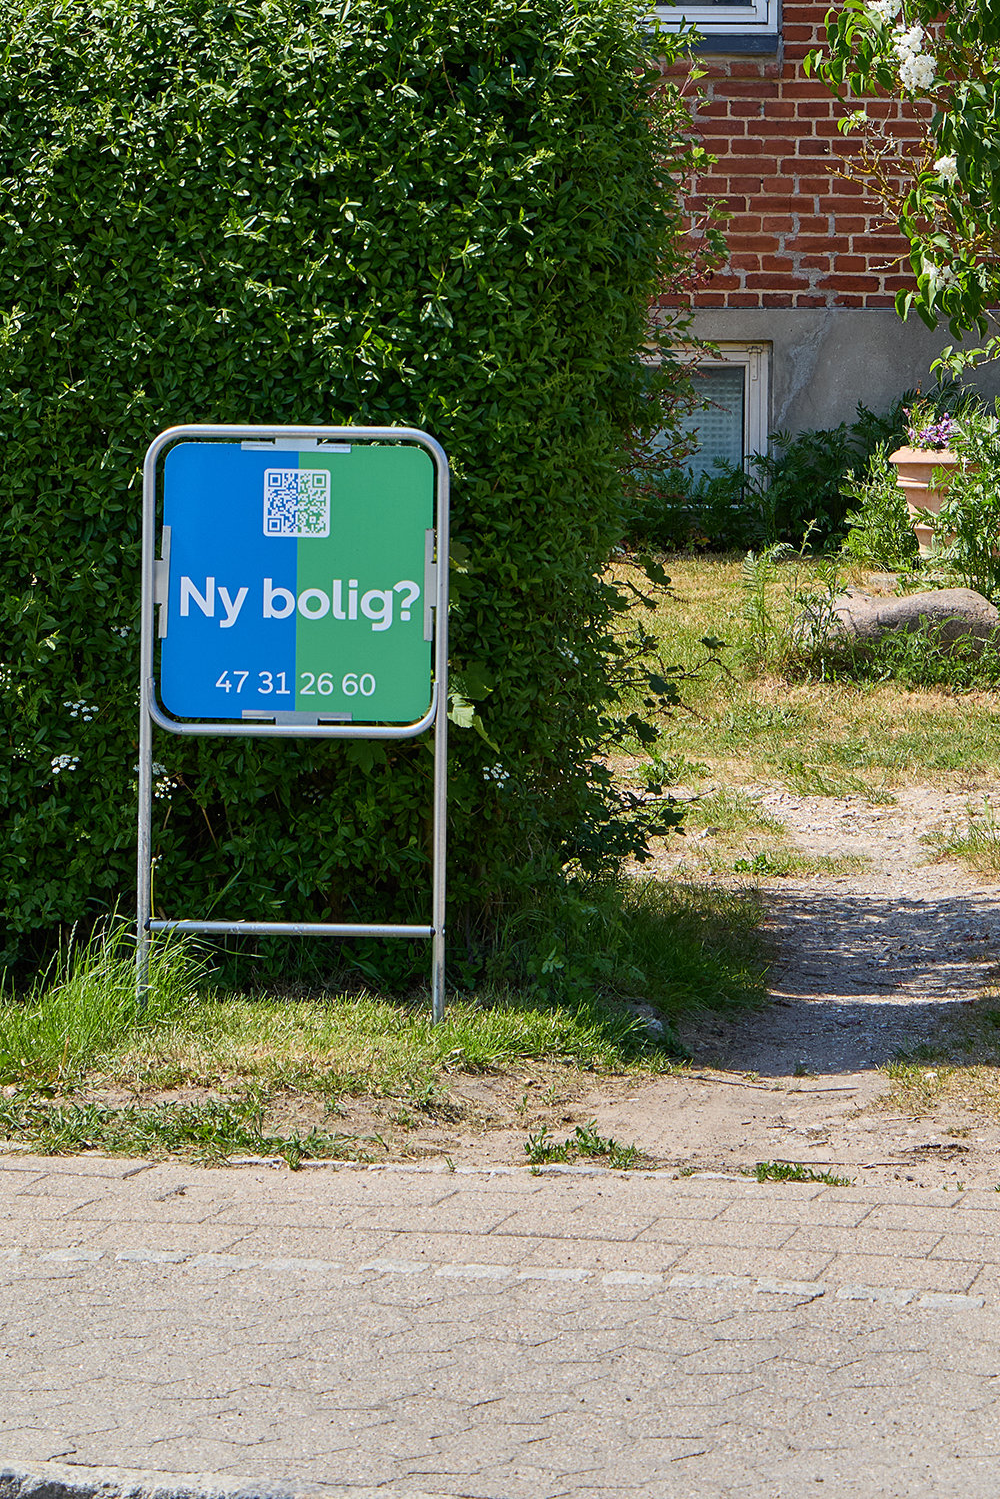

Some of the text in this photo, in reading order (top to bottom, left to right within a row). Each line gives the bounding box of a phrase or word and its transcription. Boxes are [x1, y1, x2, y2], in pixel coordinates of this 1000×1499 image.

[180, 576, 421, 632] Ny bolig?
[215, 670, 376, 697] 47 31 26 60
